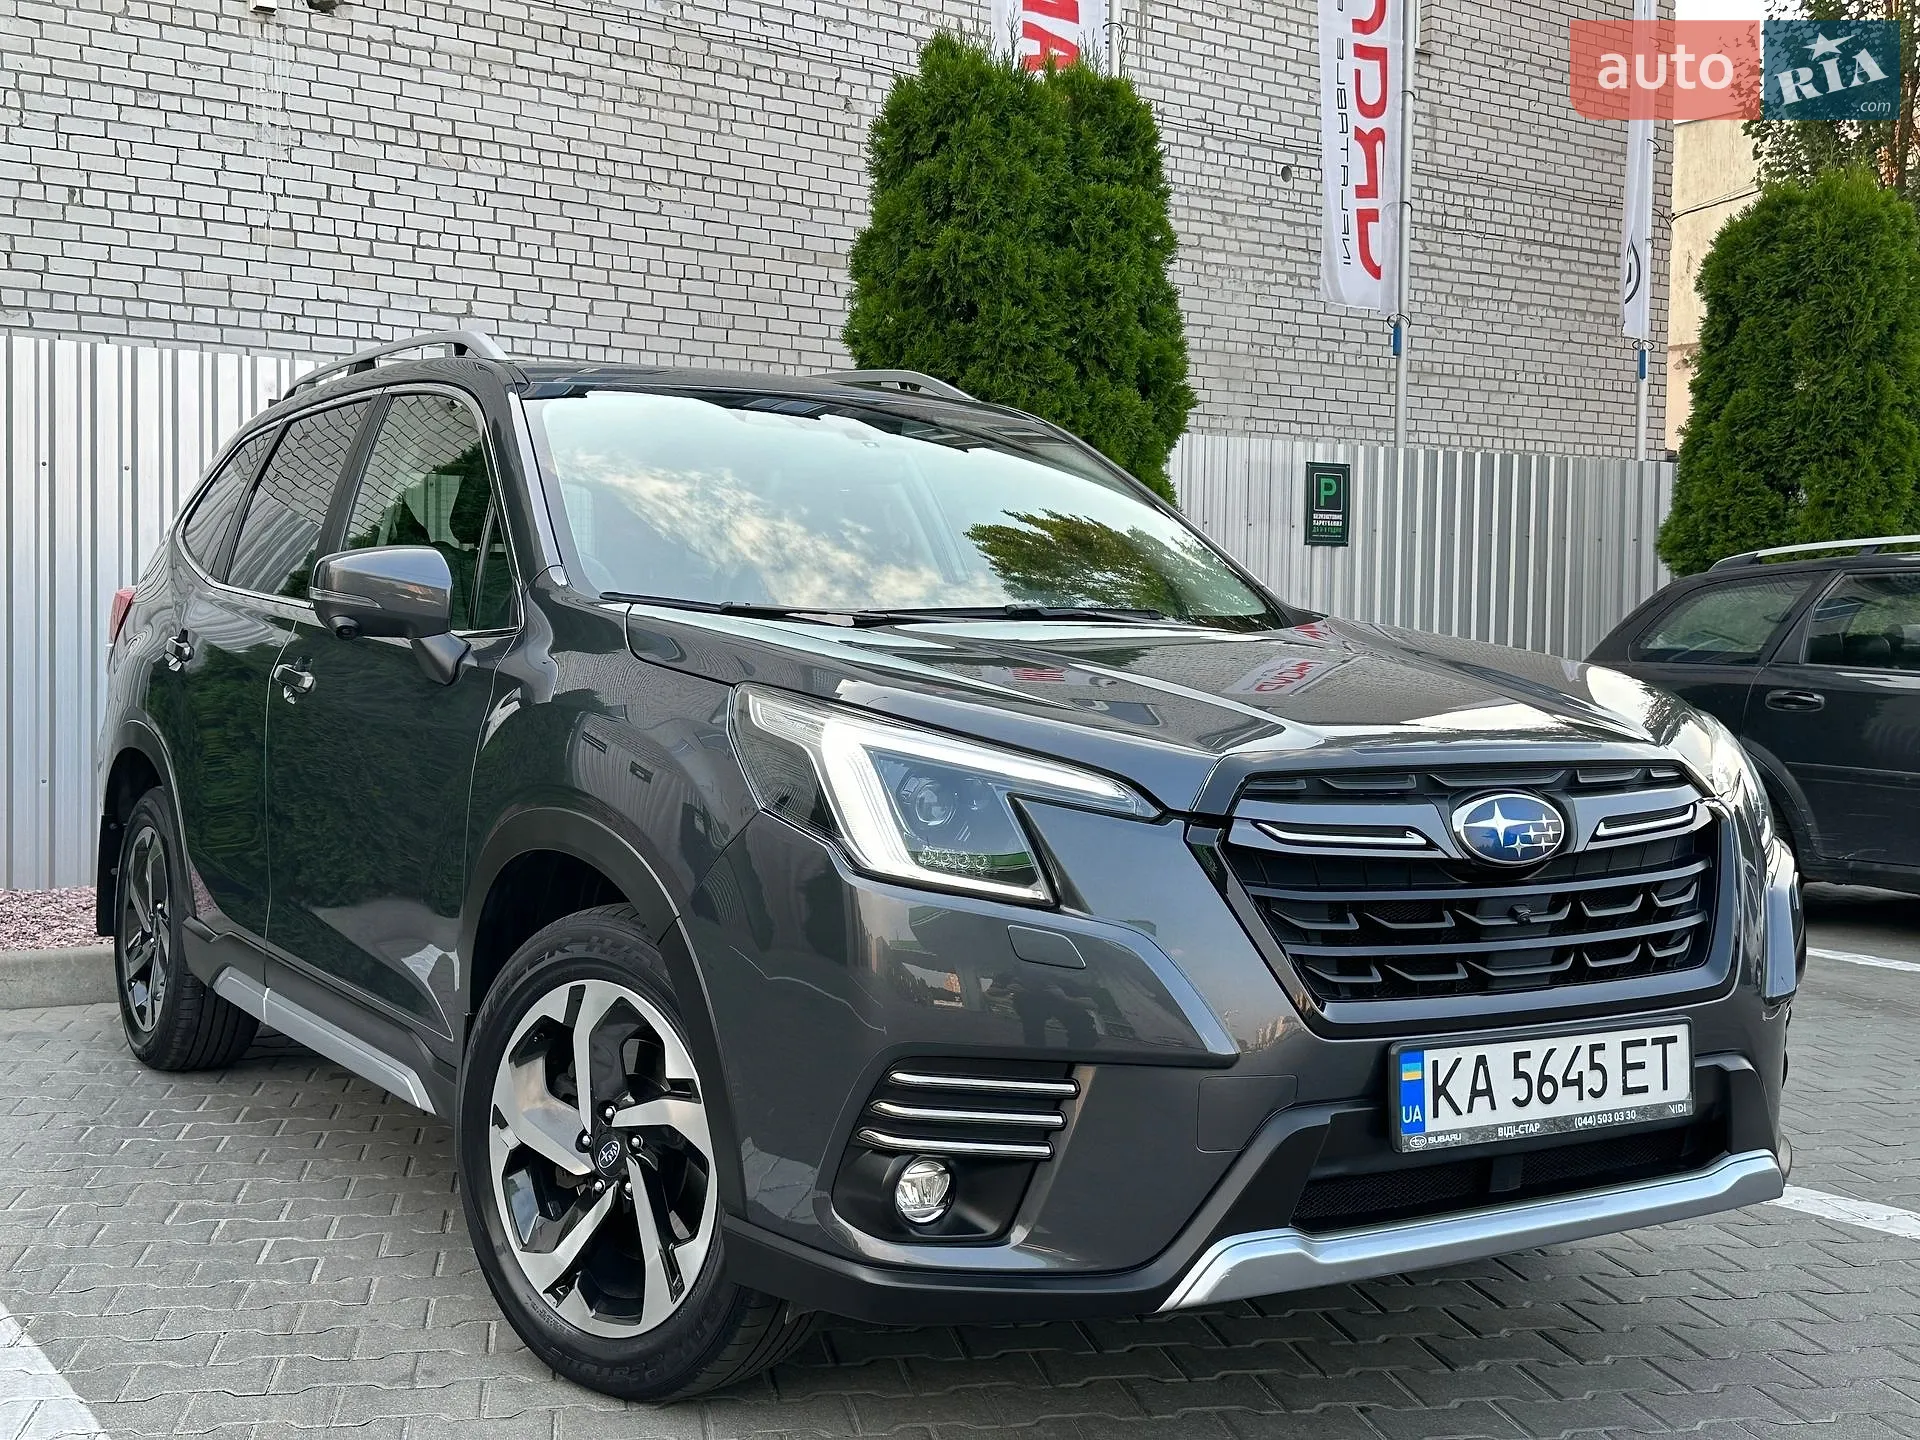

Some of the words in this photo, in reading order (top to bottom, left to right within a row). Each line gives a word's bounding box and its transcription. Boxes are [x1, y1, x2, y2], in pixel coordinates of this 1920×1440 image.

[1320, 478, 1337, 507] P
[1431, 1054, 1497, 1119] KA
[1511, 1042, 1608, 1108] 5645
[1621, 1035, 1678, 1096] ET
[1402, 1105, 1423, 1124] UA
[1668, 1103, 1687, 1114] VIDI
[1574, 1115, 1596, 1128] (044)
[1597, 1113, 1613, 1124] 503
[1614, 1111, 1625, 1122] 03
[1626, 1110, 1636, 1120] 30
[1428, 1133, 1462, 1144] SUBARU
